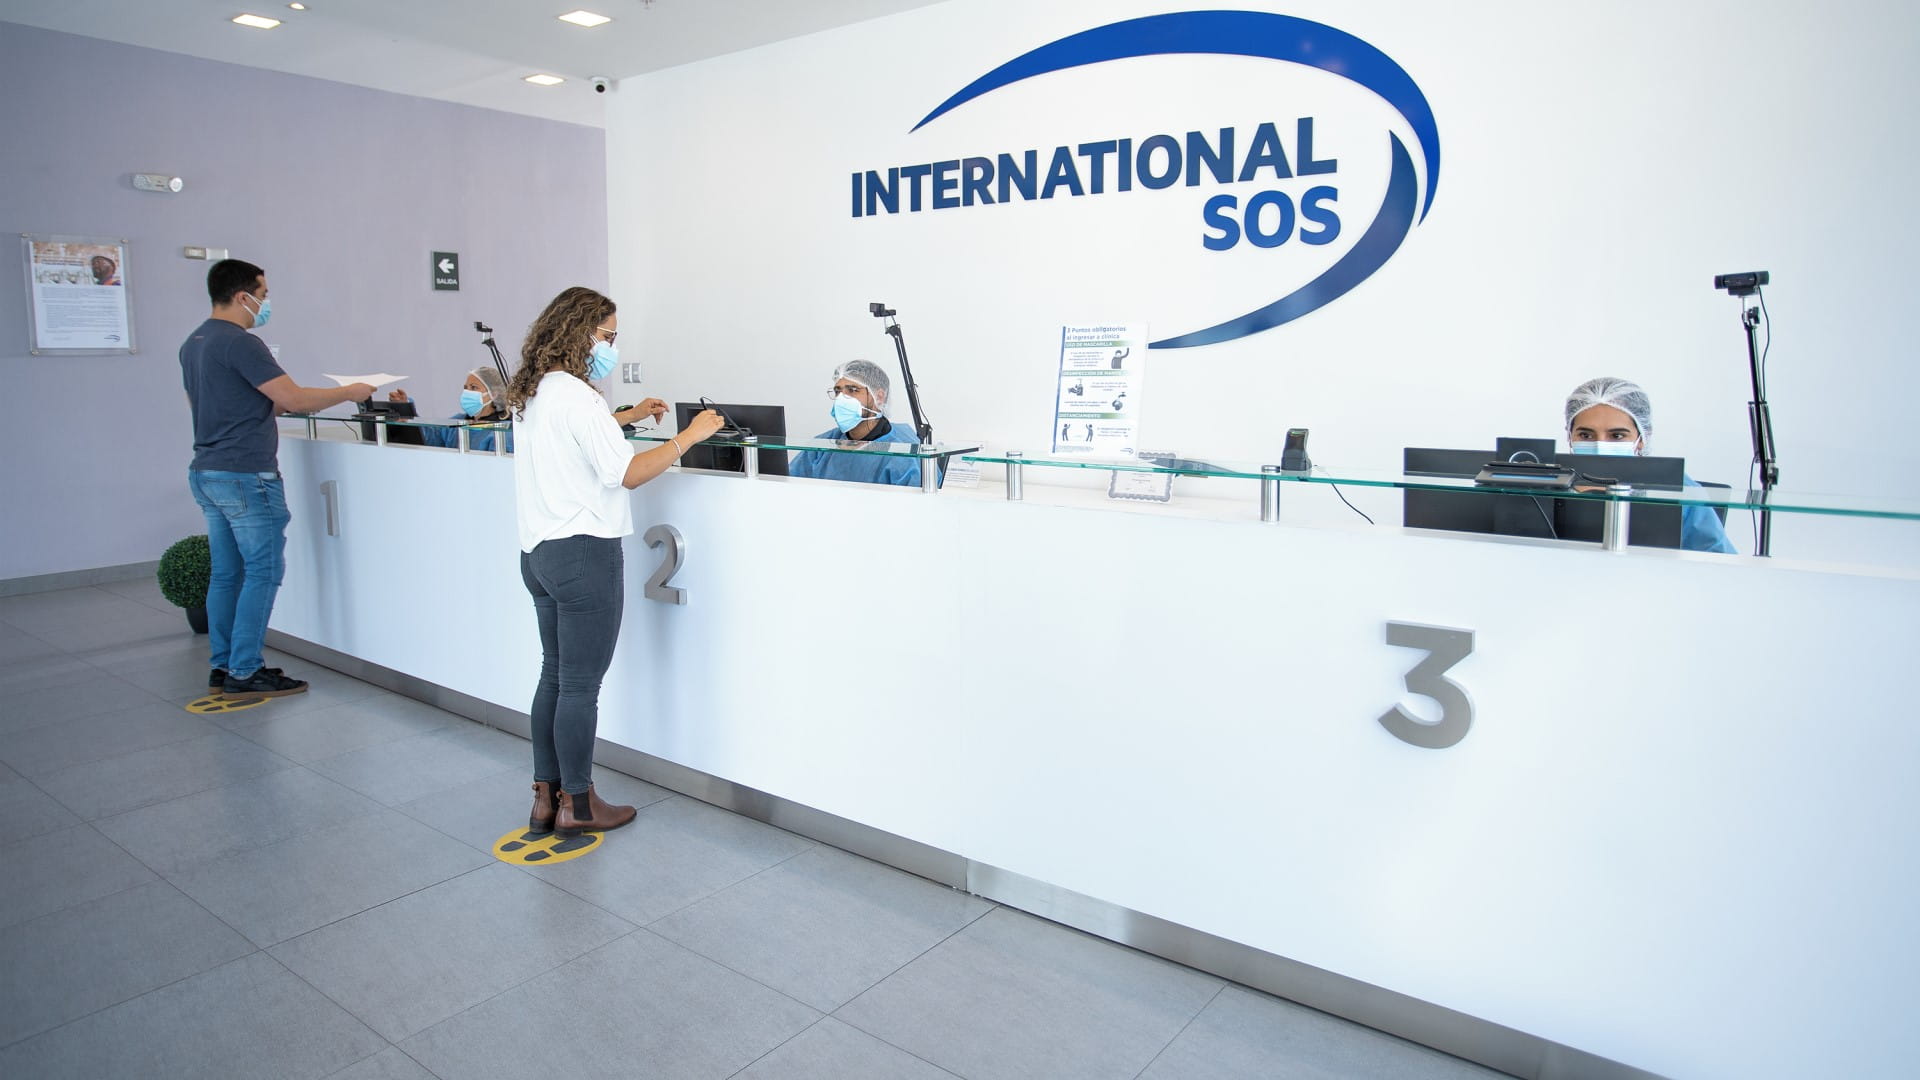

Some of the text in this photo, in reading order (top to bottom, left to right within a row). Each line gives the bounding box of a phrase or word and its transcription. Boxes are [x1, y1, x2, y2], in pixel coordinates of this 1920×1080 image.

[852, 117, 1337, 218] INTERNATIONAL
[1202, 185, 1342, 251] SOS
[320, 480, 340, 536] 1
[643, 524, 687, 605] 2
[1378, 620, 1475, 749] 3
